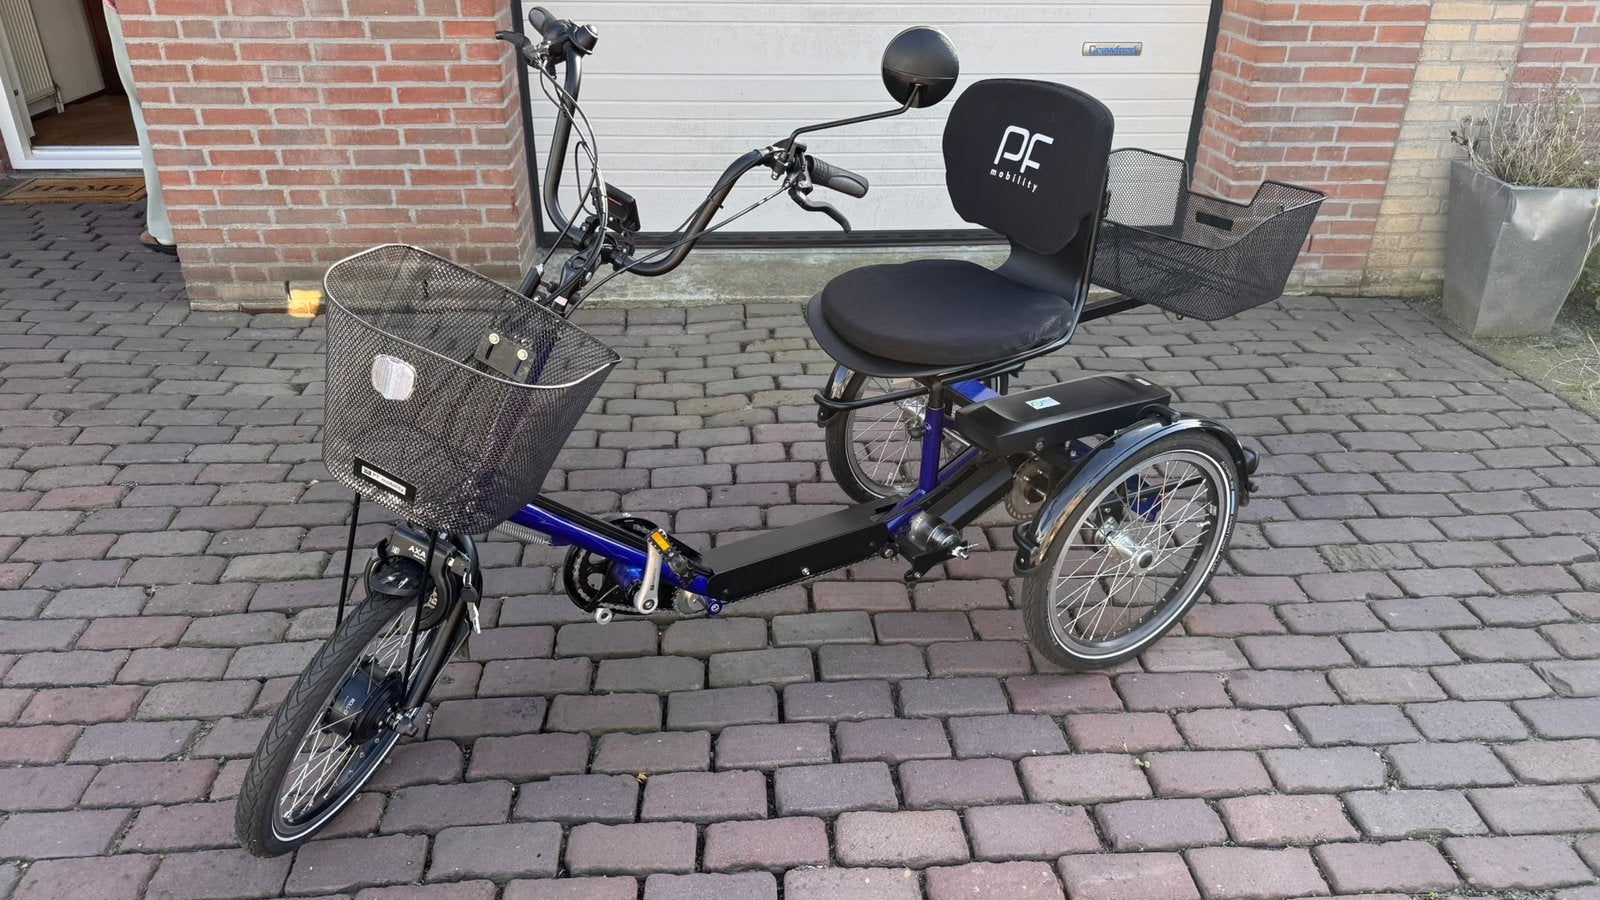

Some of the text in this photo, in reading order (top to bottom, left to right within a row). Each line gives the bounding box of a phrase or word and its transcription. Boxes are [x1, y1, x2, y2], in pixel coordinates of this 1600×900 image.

[993, 125, 1055, 174] PF
[989, 168, 1038, 193] mobility
[408, 545, 426, 559] AXA
